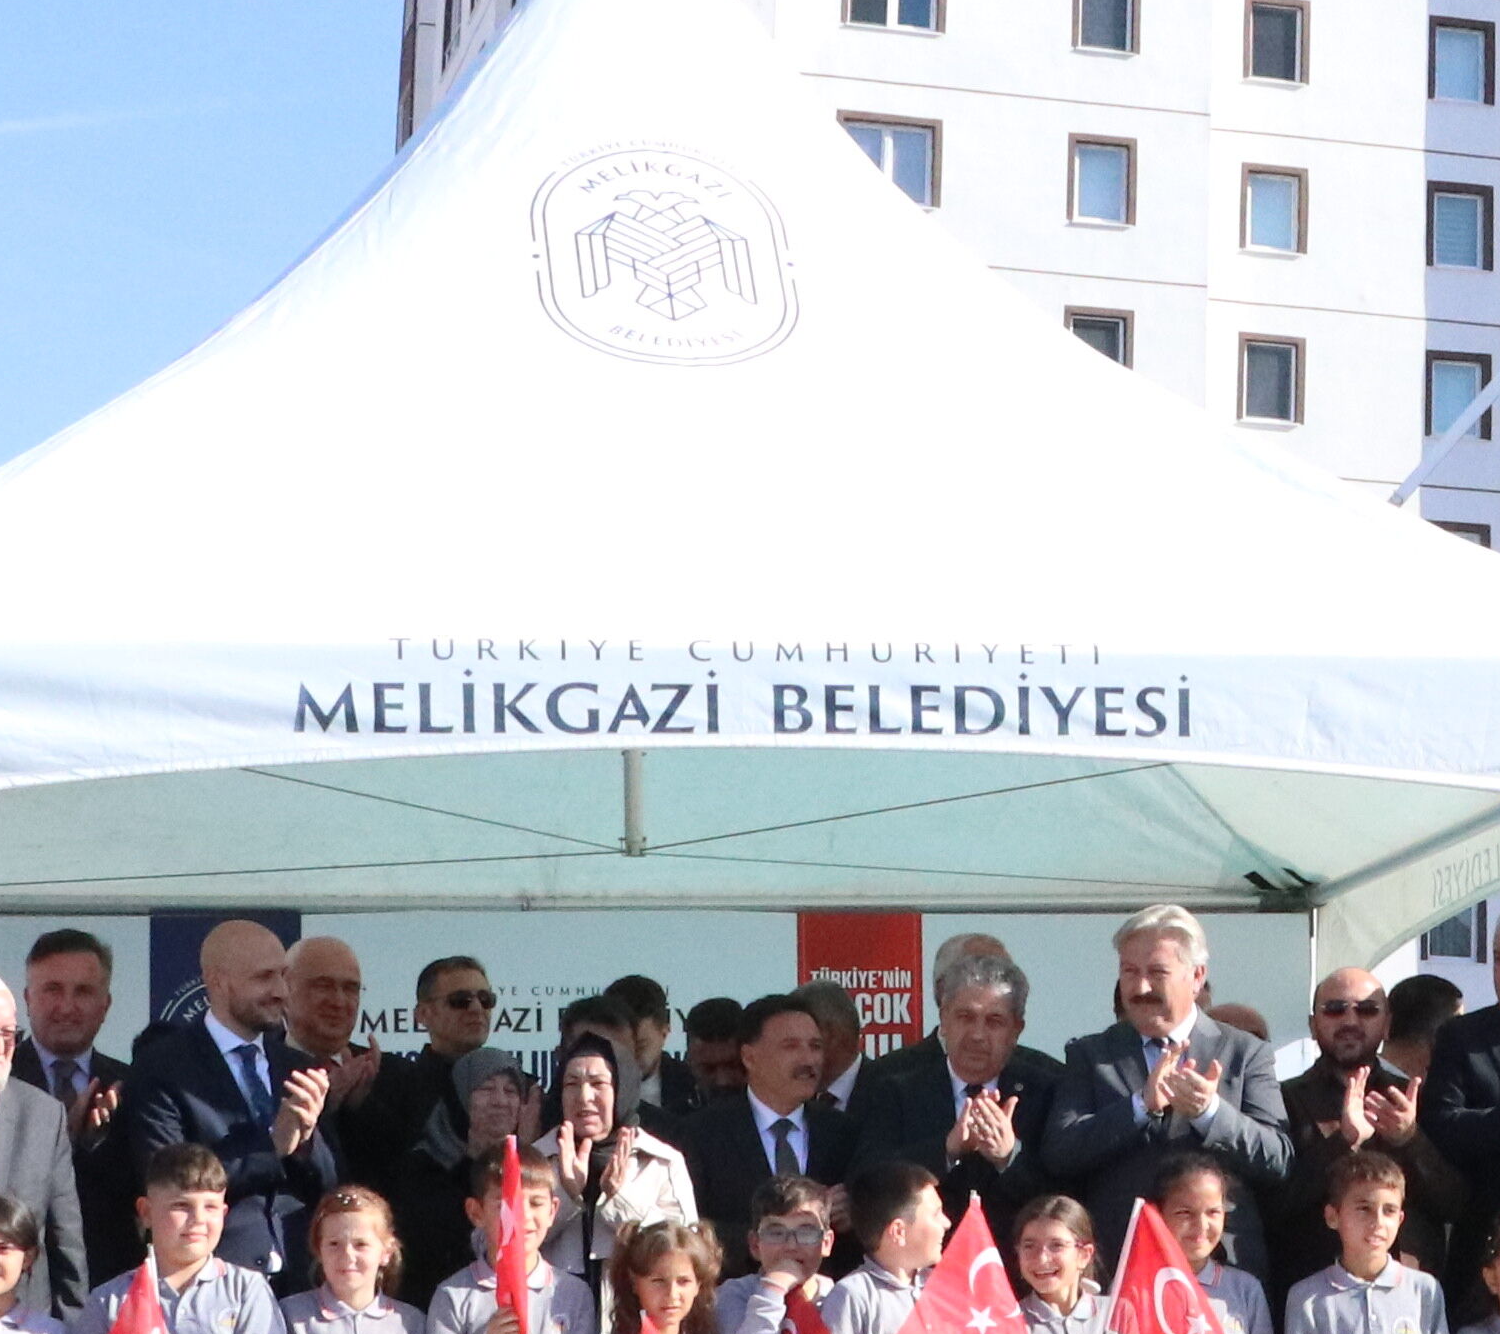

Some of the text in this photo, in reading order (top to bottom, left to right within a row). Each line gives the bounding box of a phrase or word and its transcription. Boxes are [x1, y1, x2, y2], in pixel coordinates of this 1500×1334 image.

[293, 668, 1191, 738] MELİKGAZİ BELEDİYESİ
[360, 1001, 542, 1034] MELAZİ
[854, 992, 912, 1028] ÇOK
